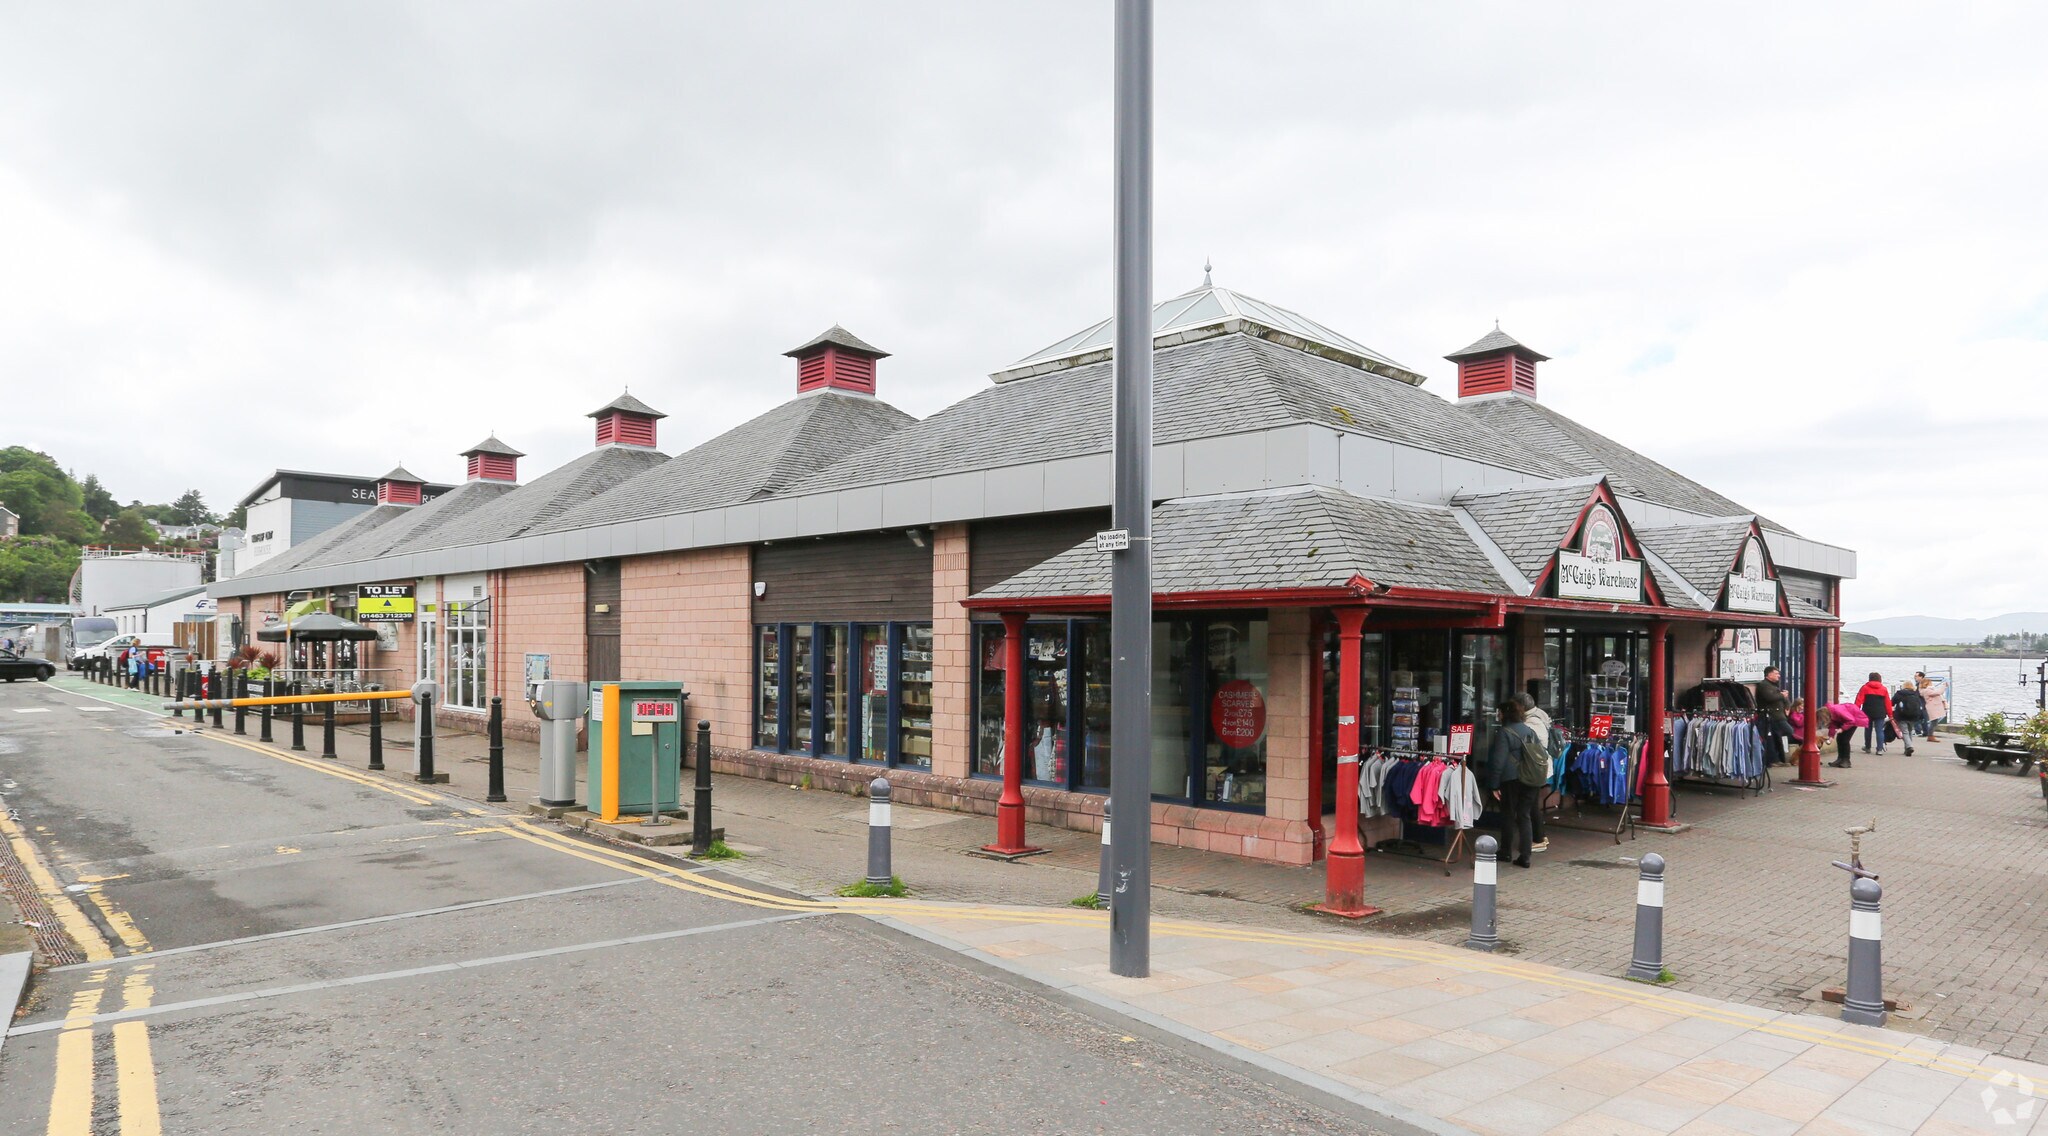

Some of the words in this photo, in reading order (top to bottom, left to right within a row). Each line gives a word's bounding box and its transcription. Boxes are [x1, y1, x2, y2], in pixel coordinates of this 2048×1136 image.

[1561, 564, 1596, 590] McCaig's
[1598, 568, 1638, 589] Warehouse
[637, 703, 673, 716] OPEN
[1590, 726, 1608, 737] £15
